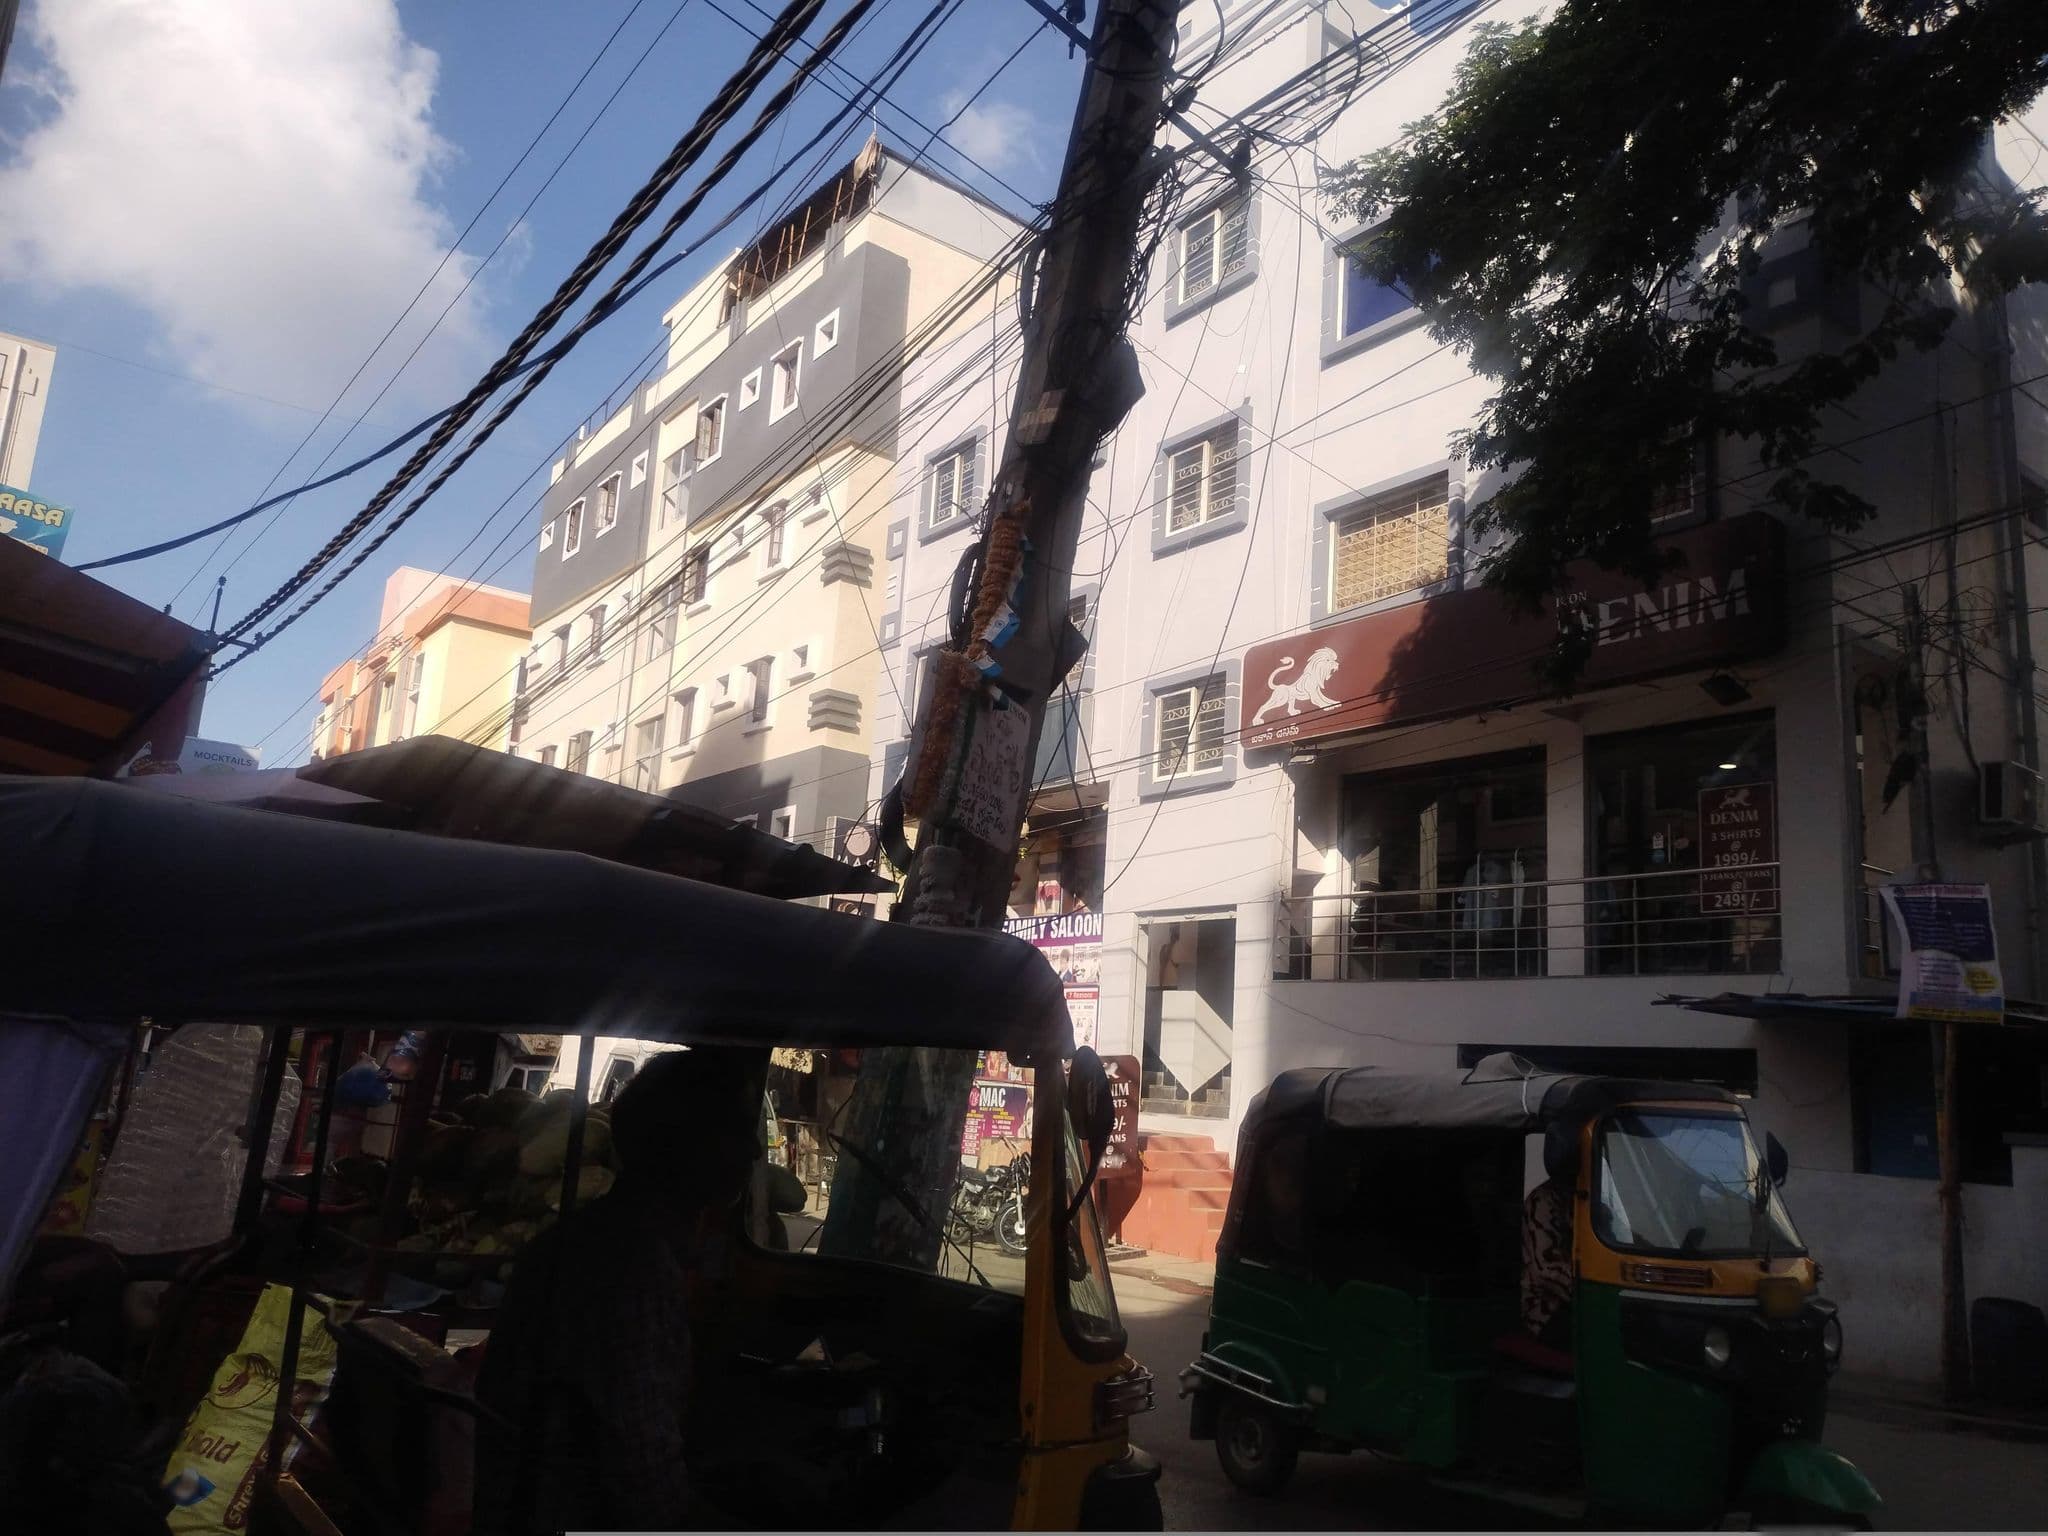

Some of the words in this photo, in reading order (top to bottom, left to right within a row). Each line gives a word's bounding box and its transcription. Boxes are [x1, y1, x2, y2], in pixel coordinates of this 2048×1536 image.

[193, 751, 252, 767] MOCKTAILS
[1710, 809, 1759, 825] DENIM
[1720, 828, 1761, 841] SHIRTS
[1714, 849, 1760, 867] 1999/-
[1050, 913, 1102, 939] SALOON
[979, 1087, 1006, 1108] MAC
[1110, 1083, 1130, 1097] NIM
[1107, 1134, 1127, 1144] ANS
[184, 1431, 241, 1464] old
